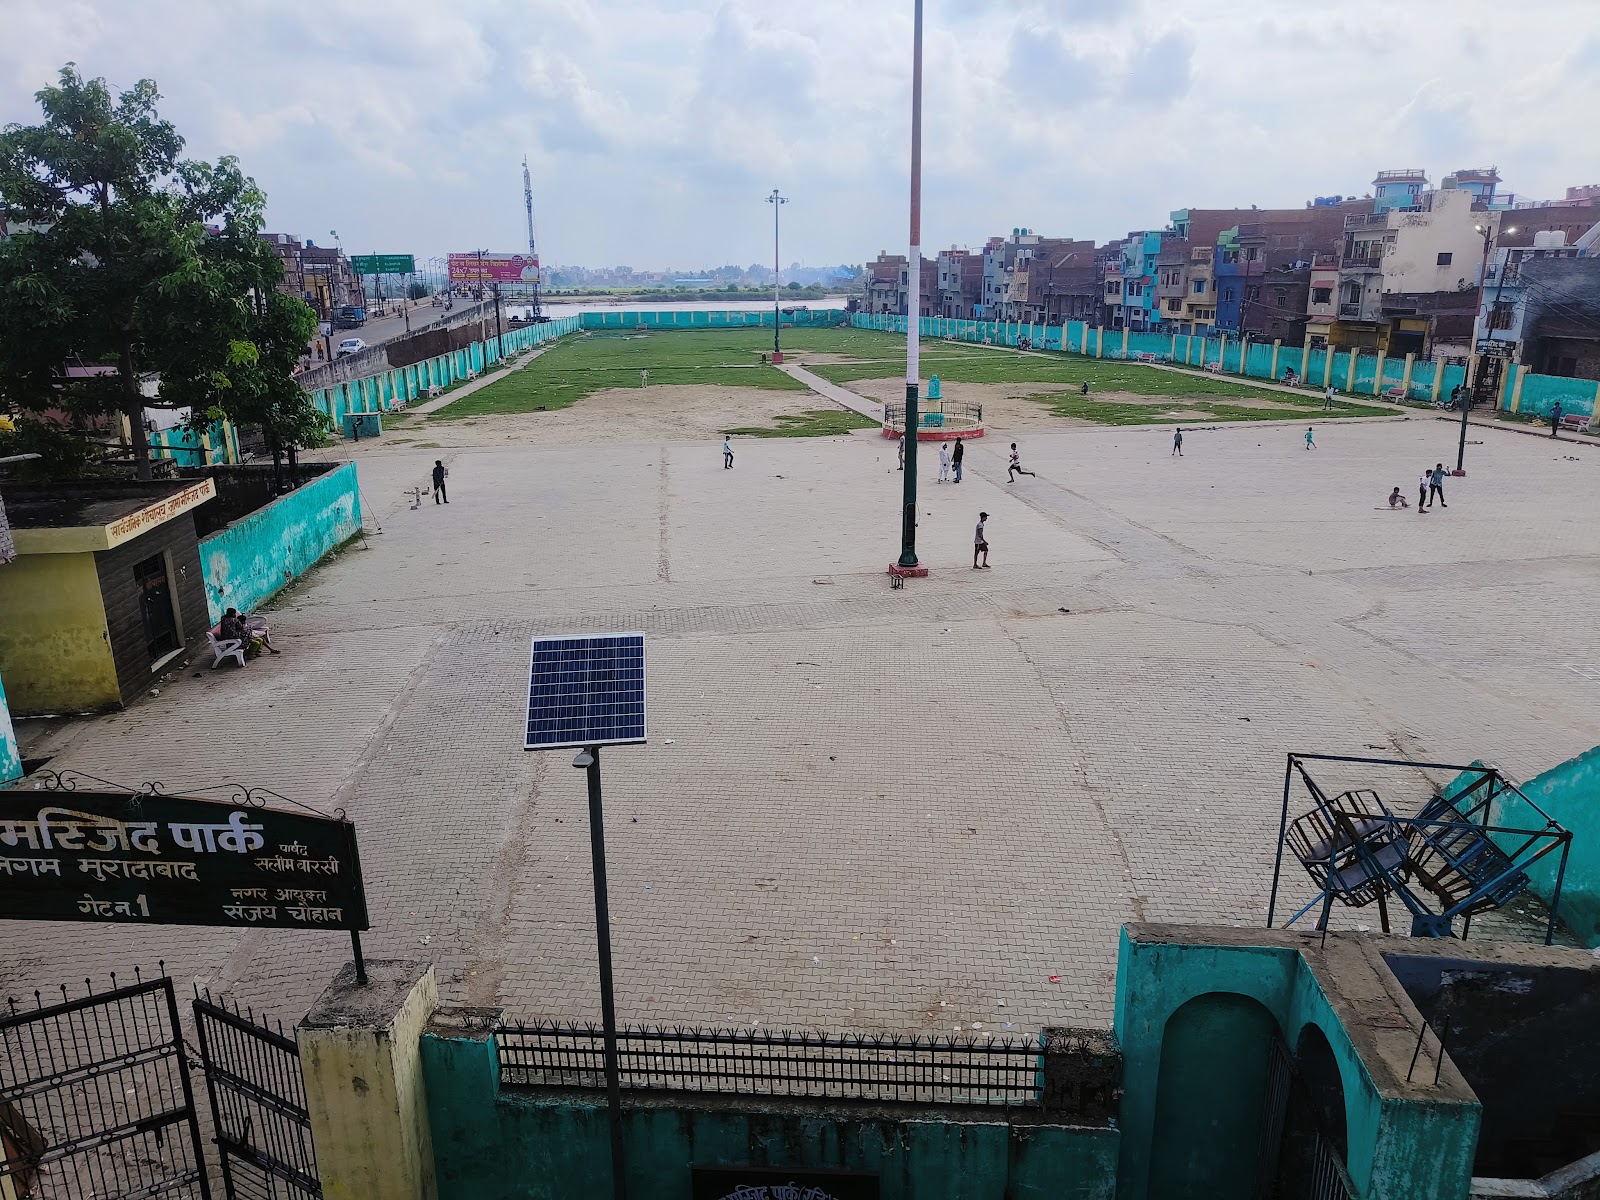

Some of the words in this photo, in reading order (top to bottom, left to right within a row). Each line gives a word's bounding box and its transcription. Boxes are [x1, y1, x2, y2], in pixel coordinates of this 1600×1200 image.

[168, 812, 264, 853] पार्क
[77, 858, 200, 881] मुरादाबाद
[254, 854, 295, 872] सलीम
[297, 855, 340, 875] वारसी
[230, 888, 267, 900] नगर
[274, 888, 327, 903] आयुक्त
[222, 901, 277, 921] संजय
